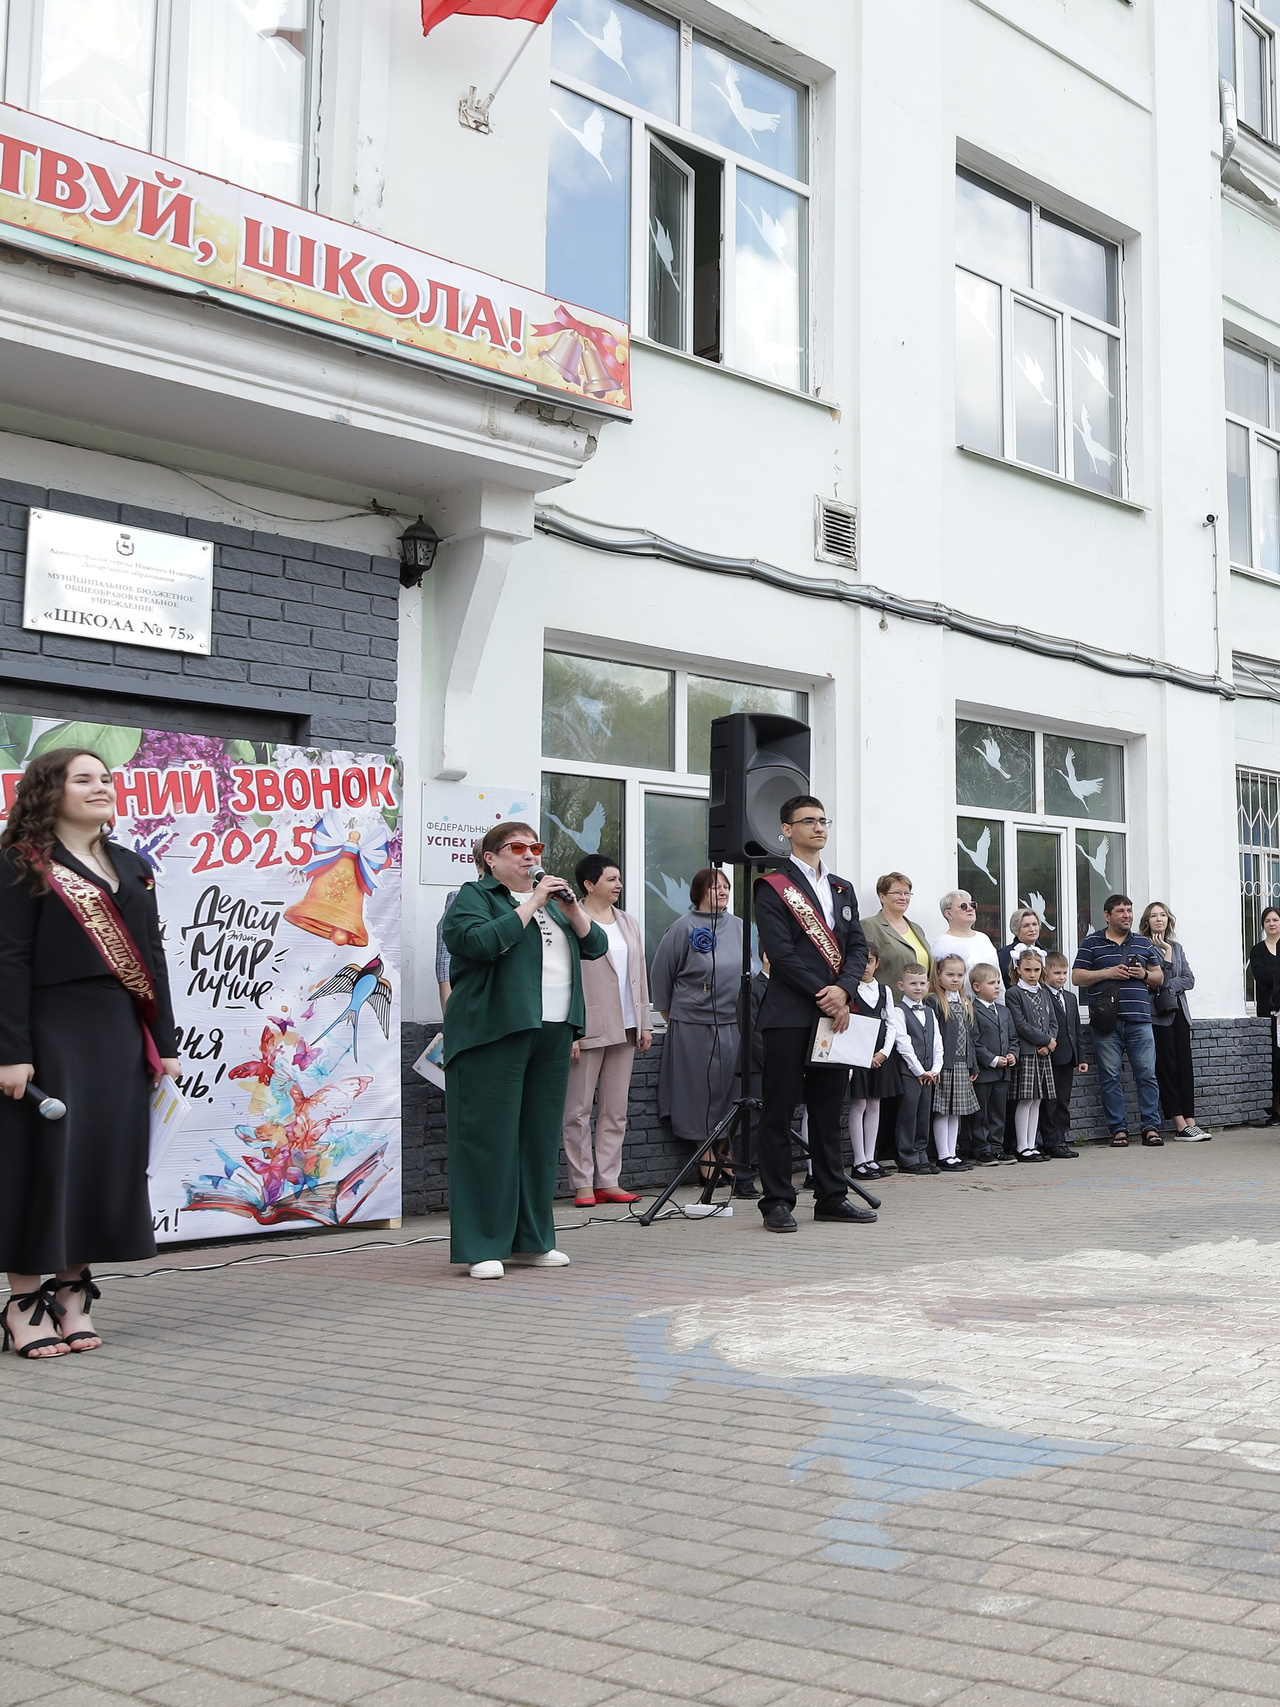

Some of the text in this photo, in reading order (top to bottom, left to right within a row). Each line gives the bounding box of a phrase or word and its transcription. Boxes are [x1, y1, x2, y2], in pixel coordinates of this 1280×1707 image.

[242, 216, 523, 353] ШКОЛА!
[47, 572, 195, 603] МУНИЦИПАЛЬНОЕ БЮДЖЕТНОЕ
[64, 583, 180, 608] ОБЩЕОБРАЗОВАТЕЛЬНОЕ
[91, 596, 154, 613] УЧРЕЖДЕНИЕ
[43, 607, 195, 641] «ШКОЛА № 75»
[232, 766, 397, 813] ЗВОНОК
[190, 827, 317, 875] 2025
[427, 835, 467, 848] УСПЕХ
[451, 853, 475, 864] РЕБ
